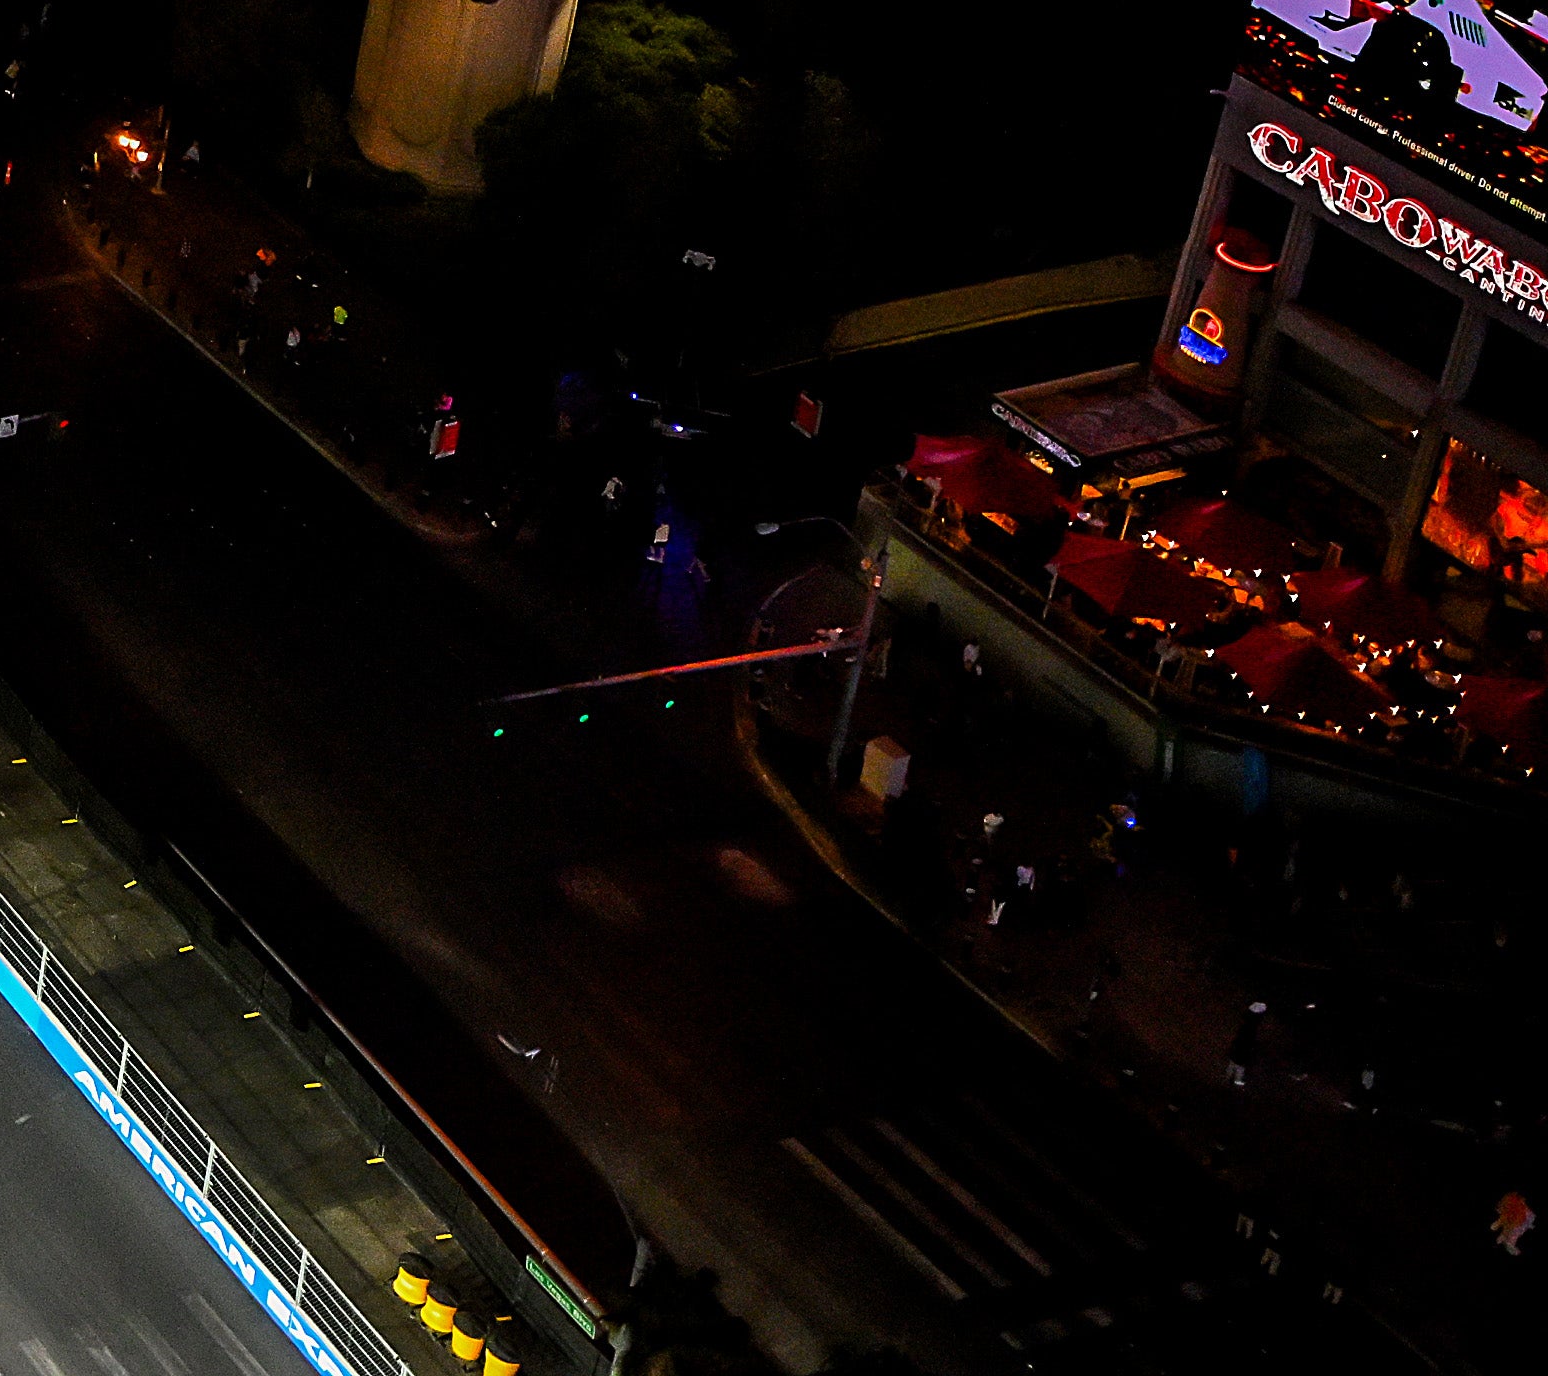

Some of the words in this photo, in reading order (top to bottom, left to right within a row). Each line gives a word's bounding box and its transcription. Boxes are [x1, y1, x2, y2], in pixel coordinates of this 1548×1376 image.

[1247, 122, 1439, 250] CABO
[1439, 217, 1548, 302] WAB
[1327, 94, 1359, 119] Closed
[1477, 177, 1493, 194] Do
[1492, 187, 1510, 203] not
[1442, 254, 1548, 327] CANTIN
[73, 1069, 257, 1286] AMERICAN
